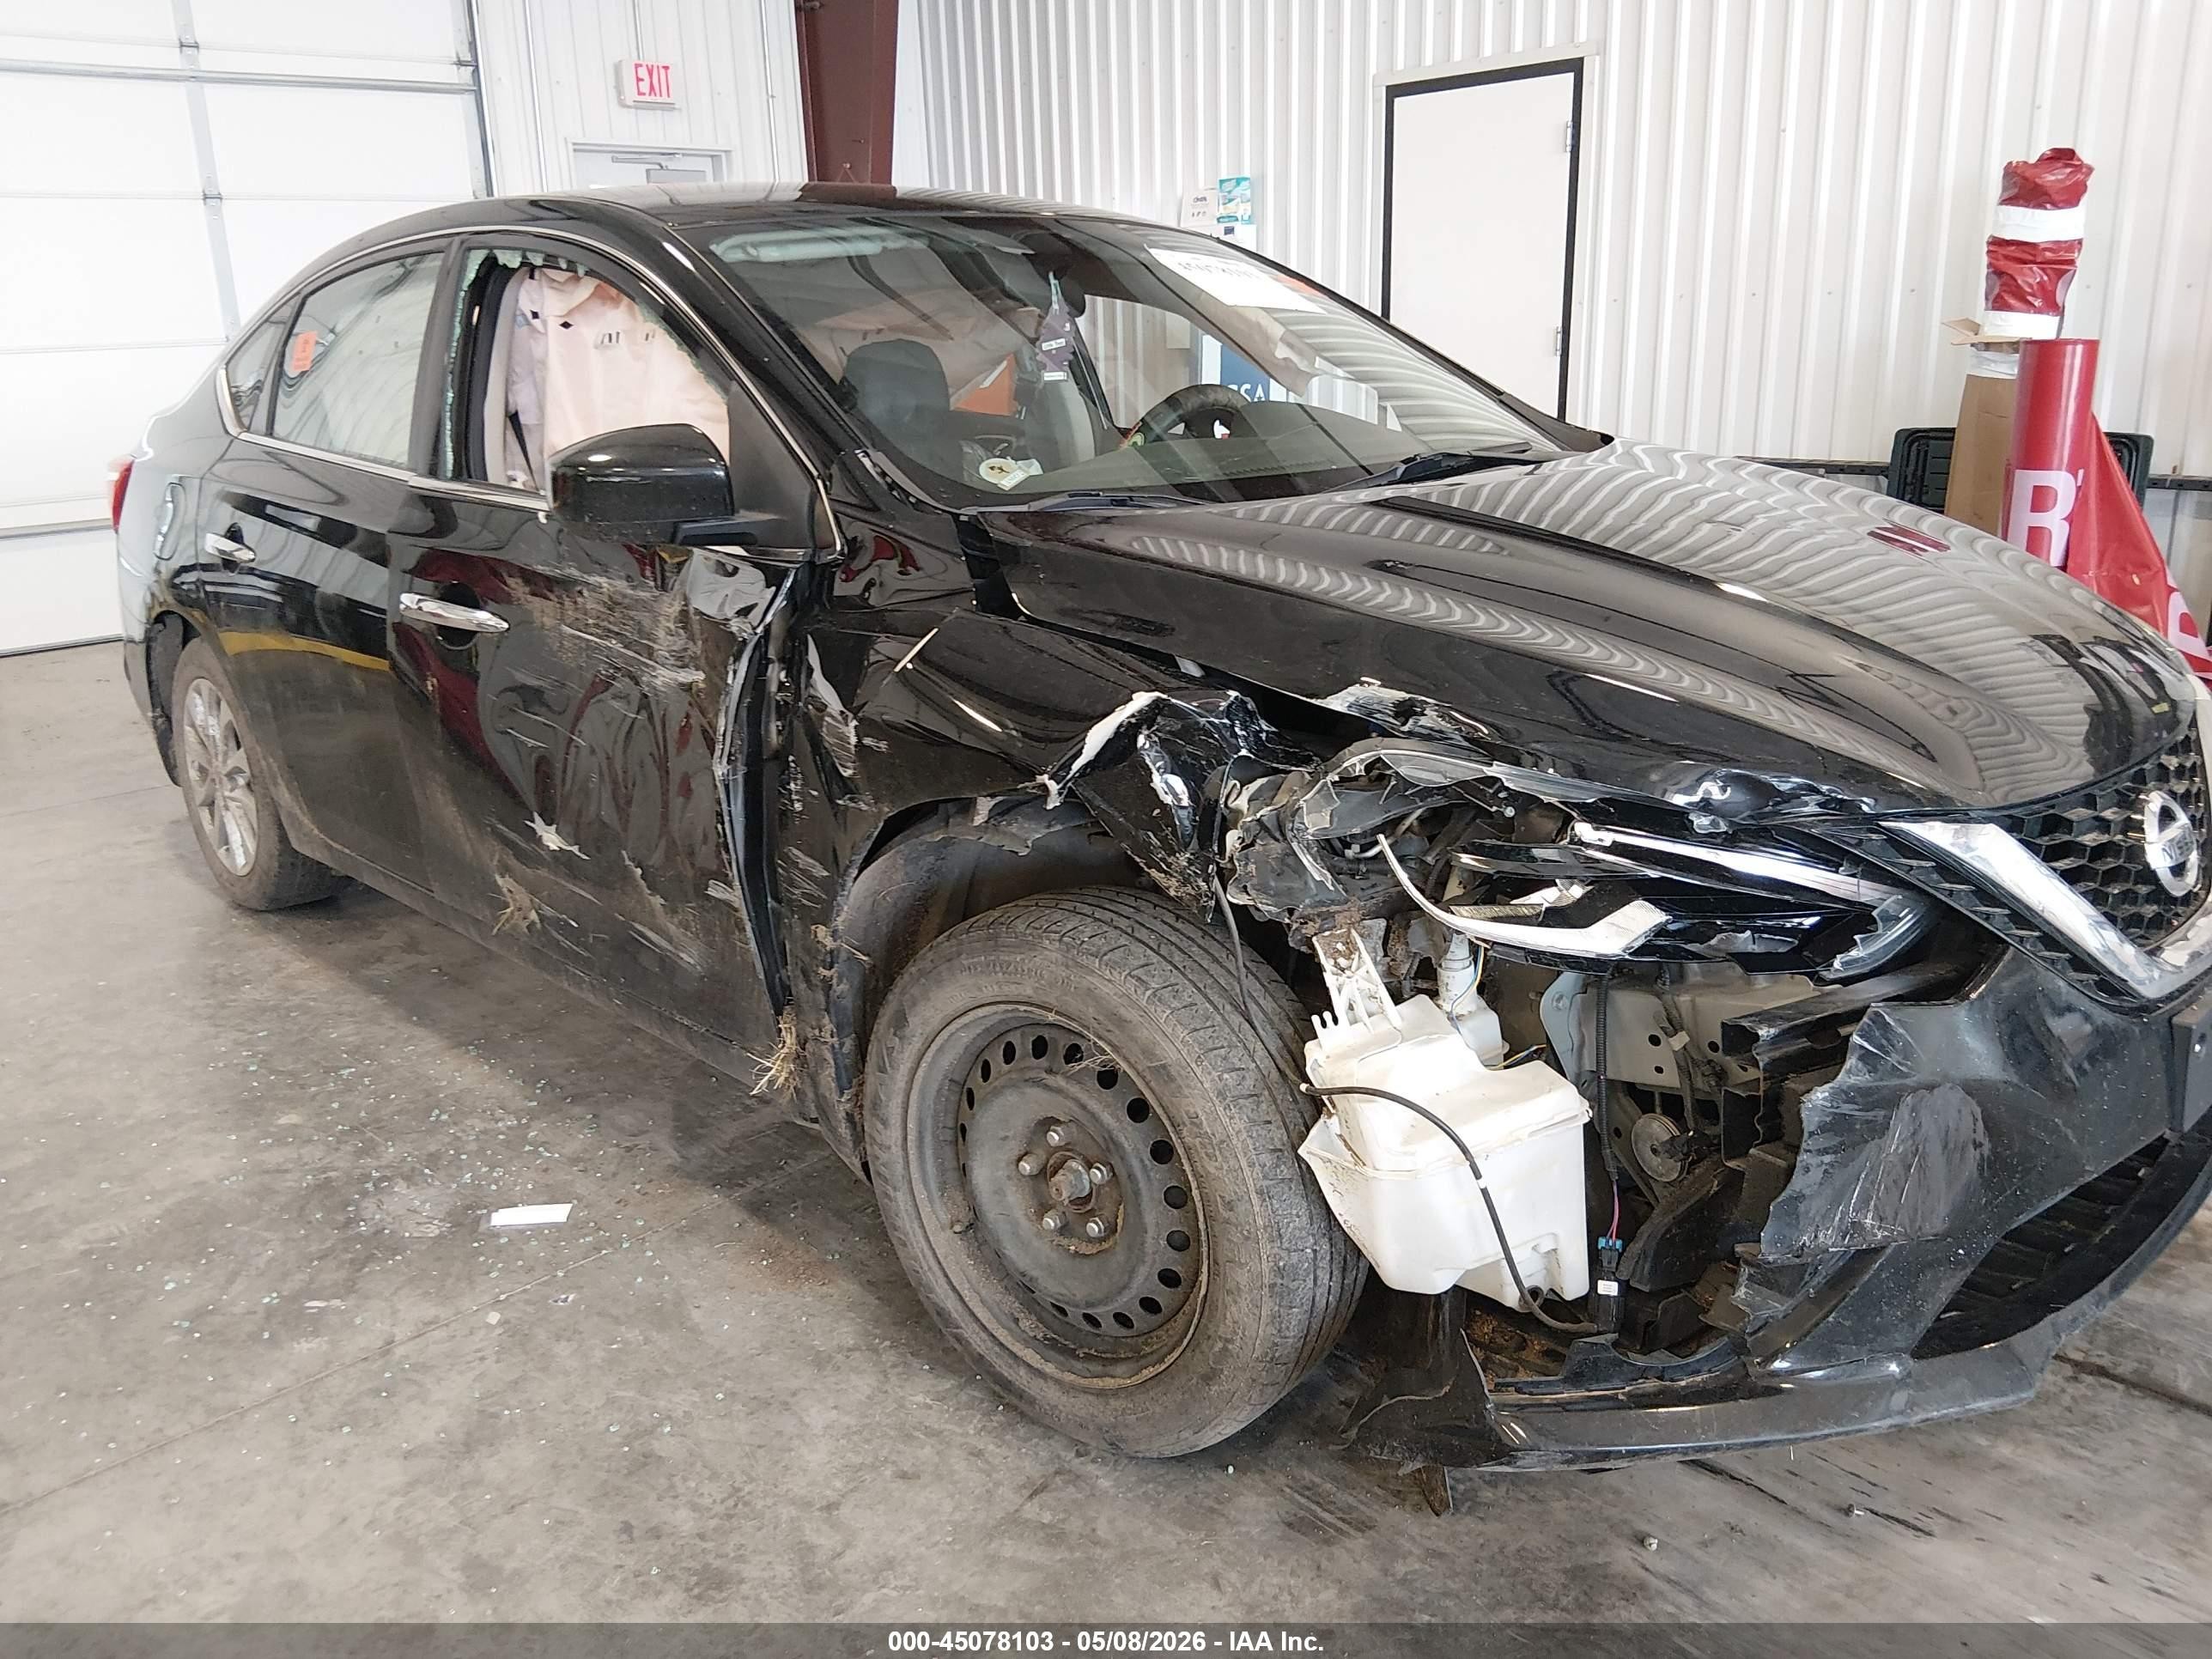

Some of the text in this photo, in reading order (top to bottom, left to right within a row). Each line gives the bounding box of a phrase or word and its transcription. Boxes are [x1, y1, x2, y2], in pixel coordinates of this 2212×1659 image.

[634, 63, 673, 99] EXIT
[1228, 383, 1266, 403] SA
[2008, 469, 2084, 567] R
